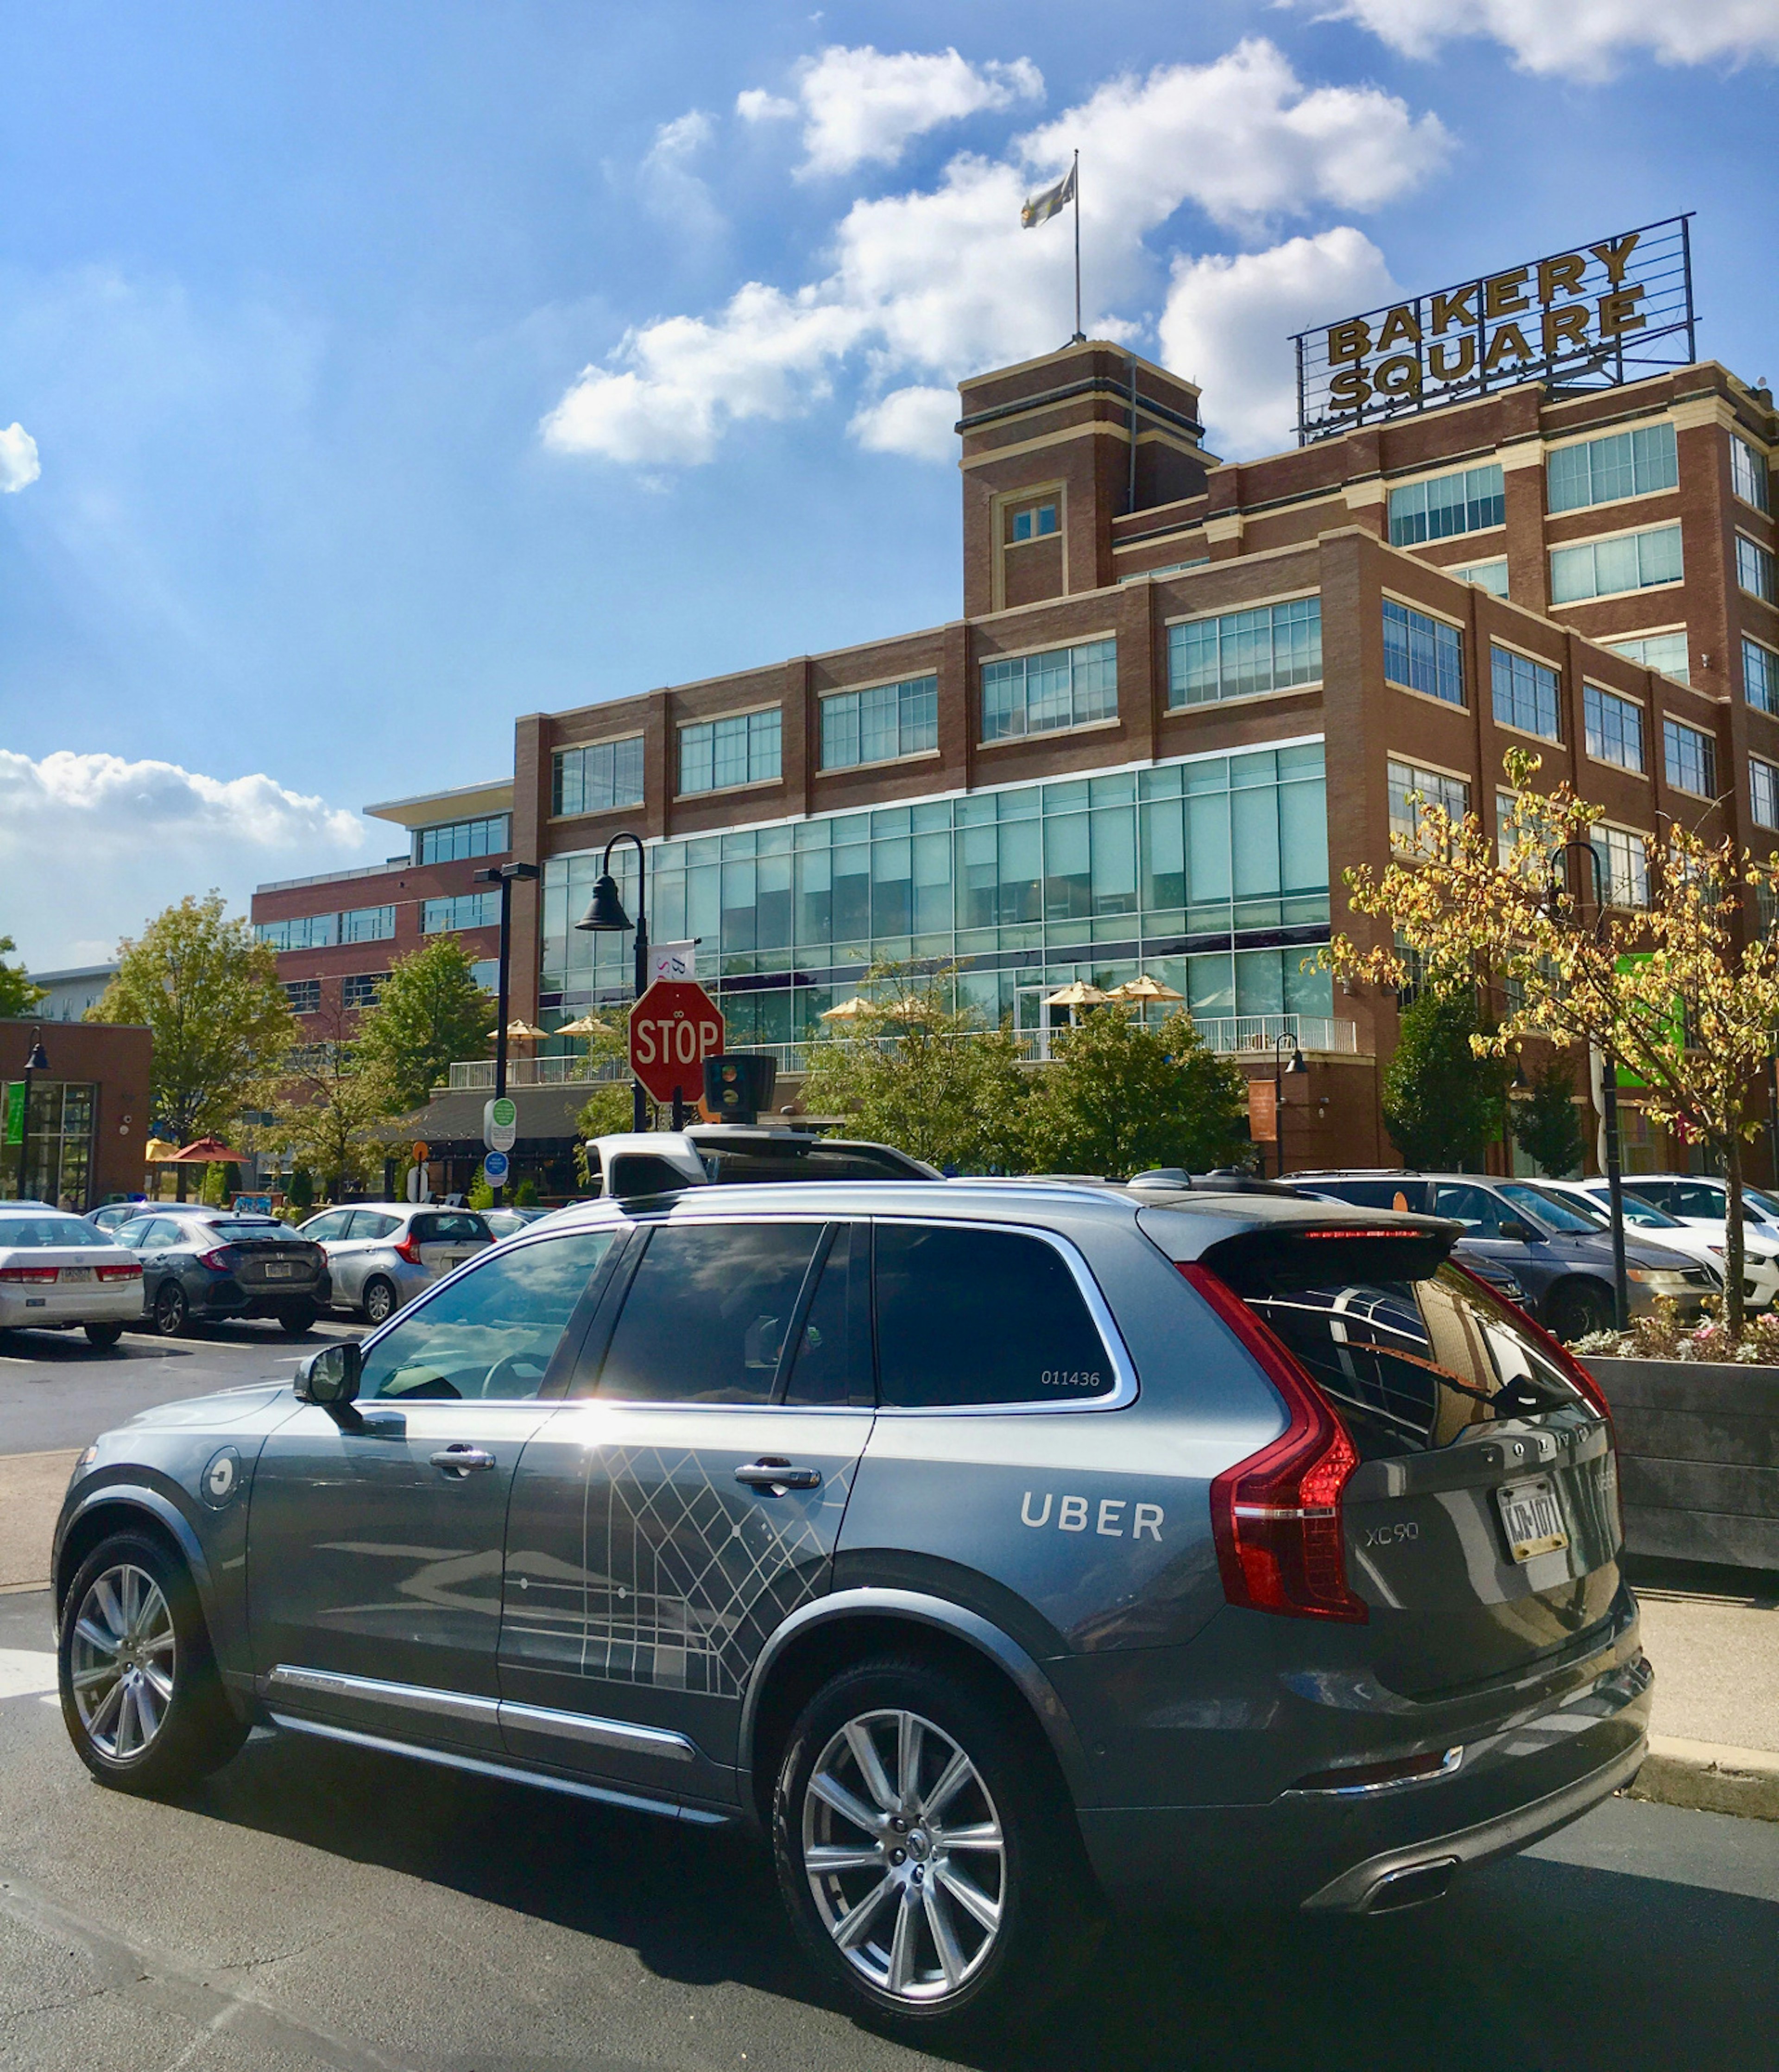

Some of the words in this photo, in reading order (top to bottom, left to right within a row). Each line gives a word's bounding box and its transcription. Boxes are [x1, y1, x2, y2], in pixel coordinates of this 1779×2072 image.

[1328, 234, 1640, 366] BAKERY
[1329, 284, 1646, 411] SQUARE
[636, 1019, 719, 1064] STOP
[1041, 1371, 1100, 1387] 011436
[1021, 1491, 1165, 1542] UBER
[1365, 1522, 1419, 1547] XC90
